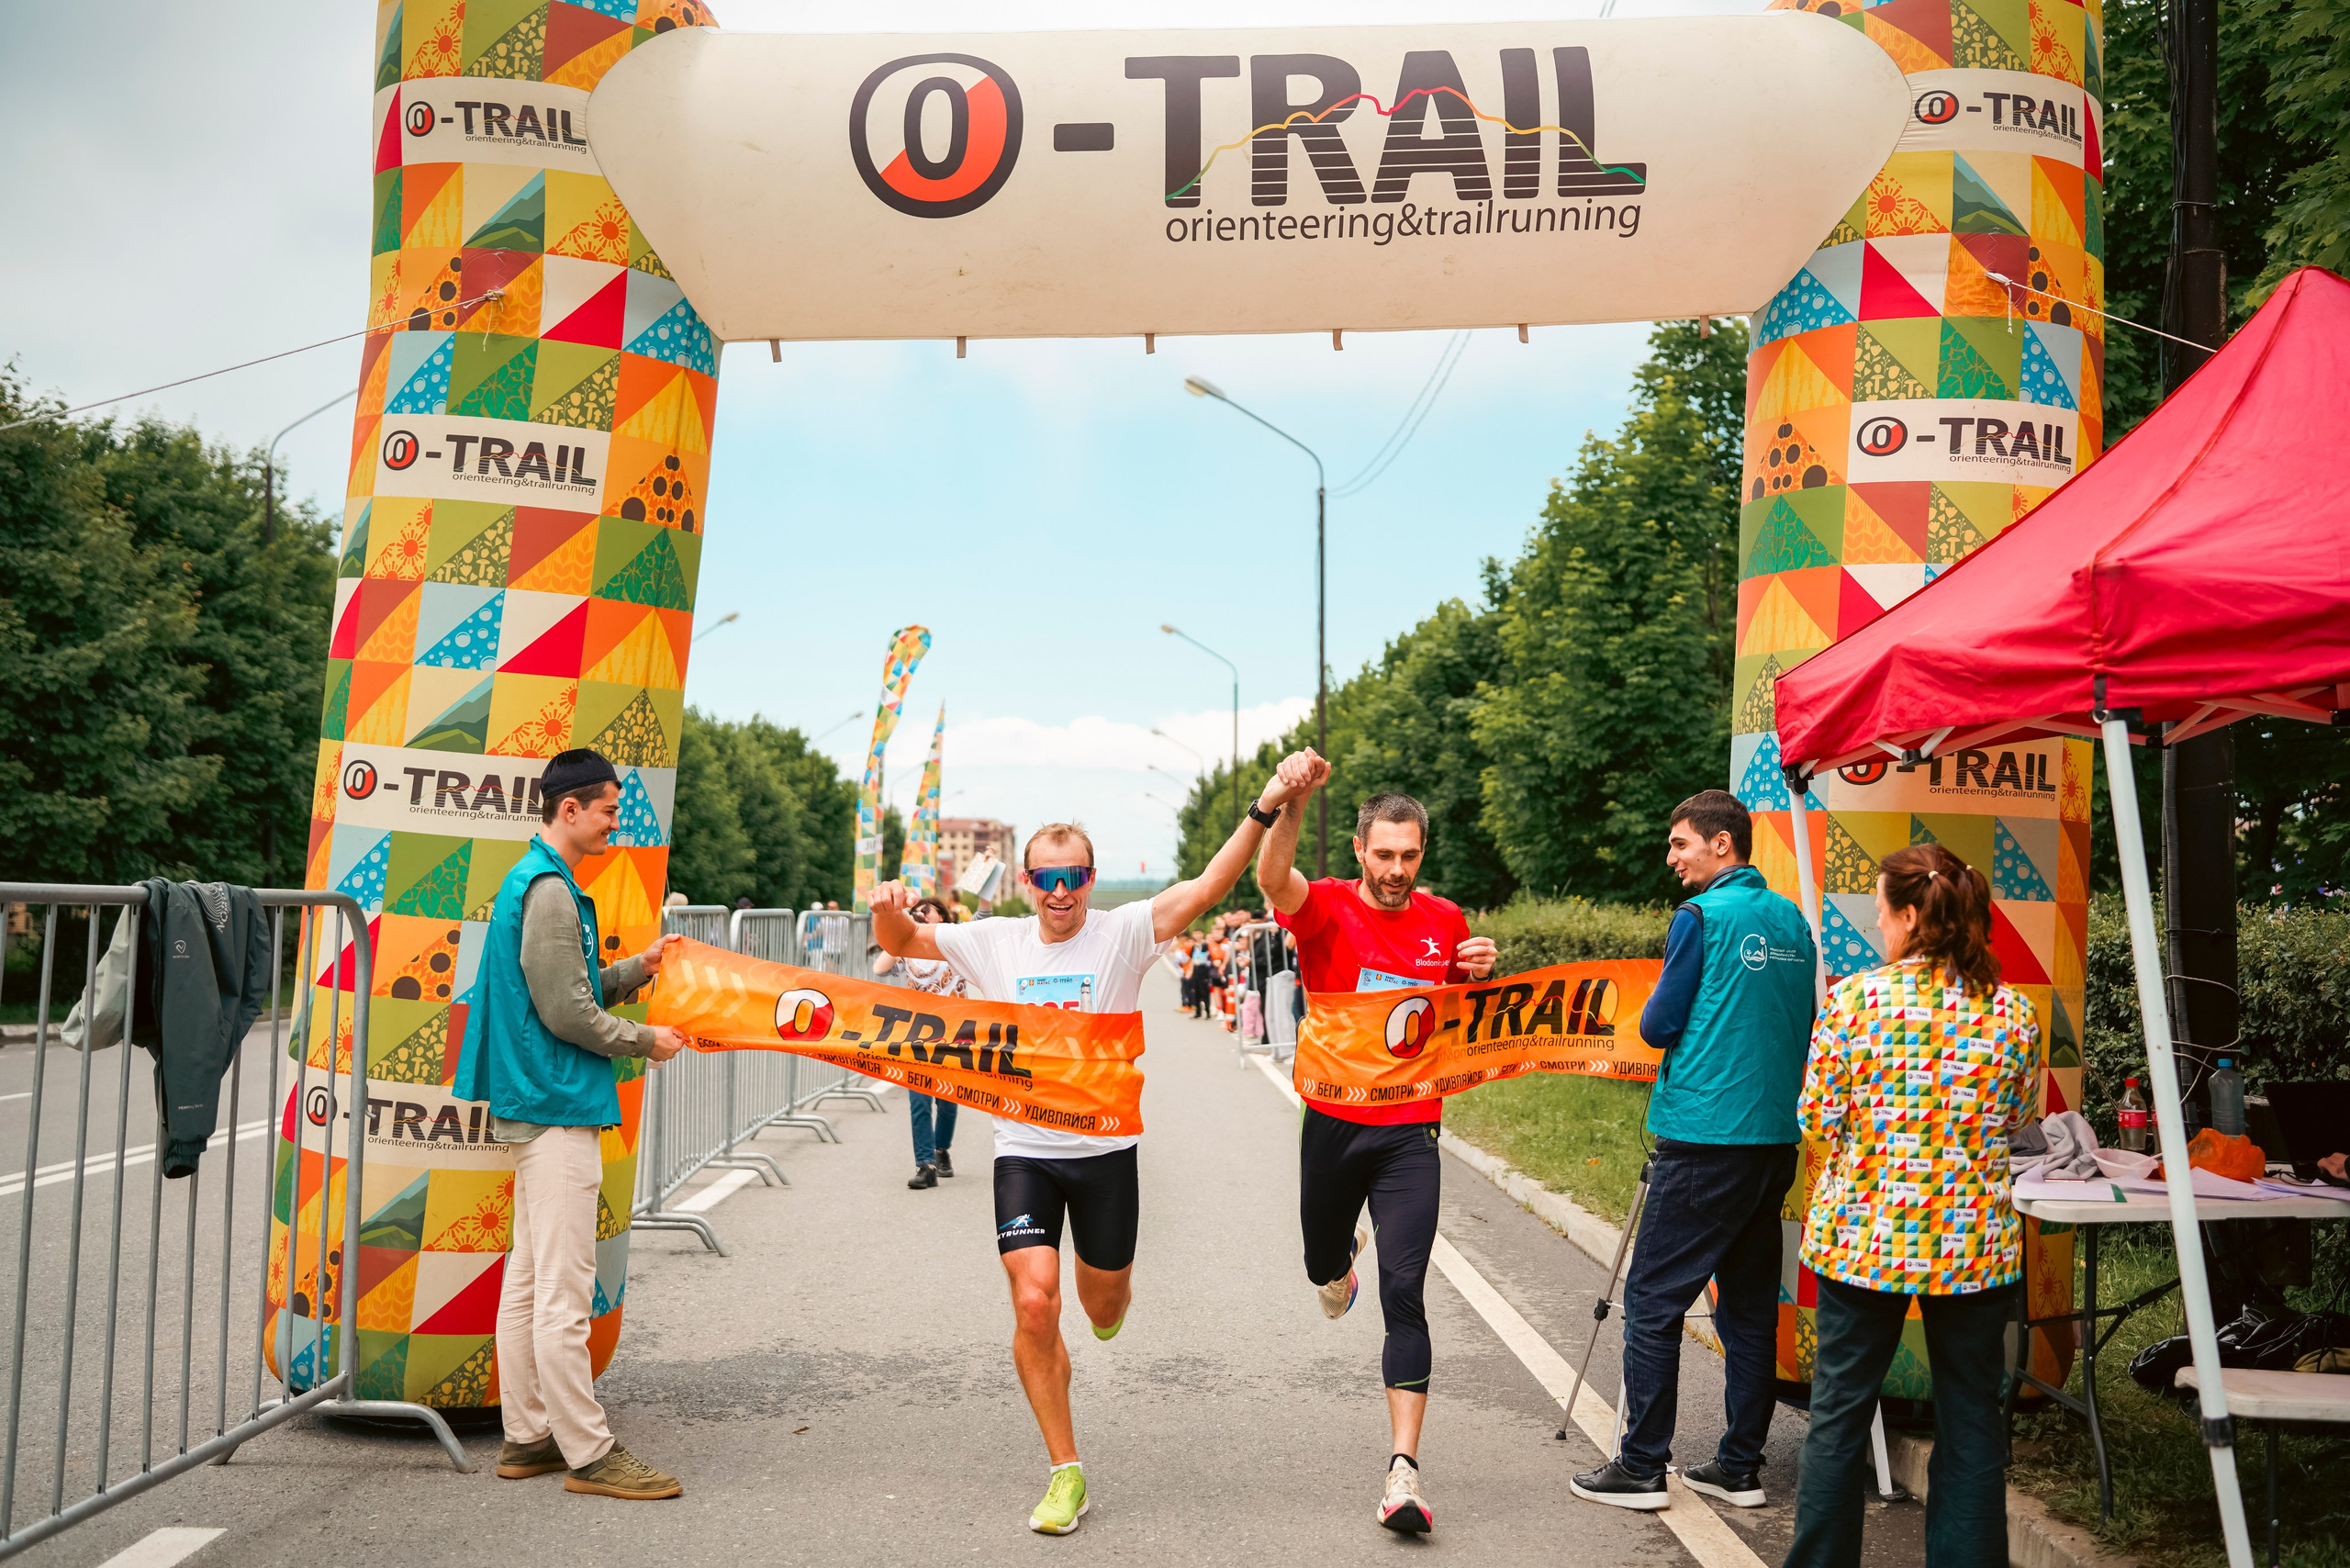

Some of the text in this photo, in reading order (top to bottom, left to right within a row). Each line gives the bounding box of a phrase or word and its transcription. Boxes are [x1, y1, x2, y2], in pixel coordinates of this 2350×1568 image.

[465, 135, 587, 154] orienteering&trailrunning
[1993, 125, 2082, 150] orienteering&trailrunning
[1165, 200, 1641, 245] orienteering&trailrunning
[1949, 454, 2071, 475] orienteering&trailrunning
[453, 473, 596, 496] orienteering&trailrunning
[1930, 786, 2055, 801] orienteering&trailrunning
[409, 805, 543, 823] orienteering&trailrunnin
[1467, 1034, 1615, 1057] orienteering&trailrunning
[1317, 1081, 1342, 1099] БЕГИ
[1370, 1083, 1415, 1101] СМОТРИ
[1433, 1070, 1483, 1093] УДИВЛЯЙСЯ
[1539, 1060, 1586, 1071] СМОТРИ
[1612, 1060, 1661, 1077] УДИВЛЯ
[907, 1071, 933, 1090] БЕГИ
[957, 1085, 1001, 1109] СМОТРИ
[1024, 1103, 1096, 1130] УДИВЛЯЙСЯ
[368, 1137, 509, 1154] orienteering&trailrunning
[997, 1228, 1046, 1239] YRUNNER
